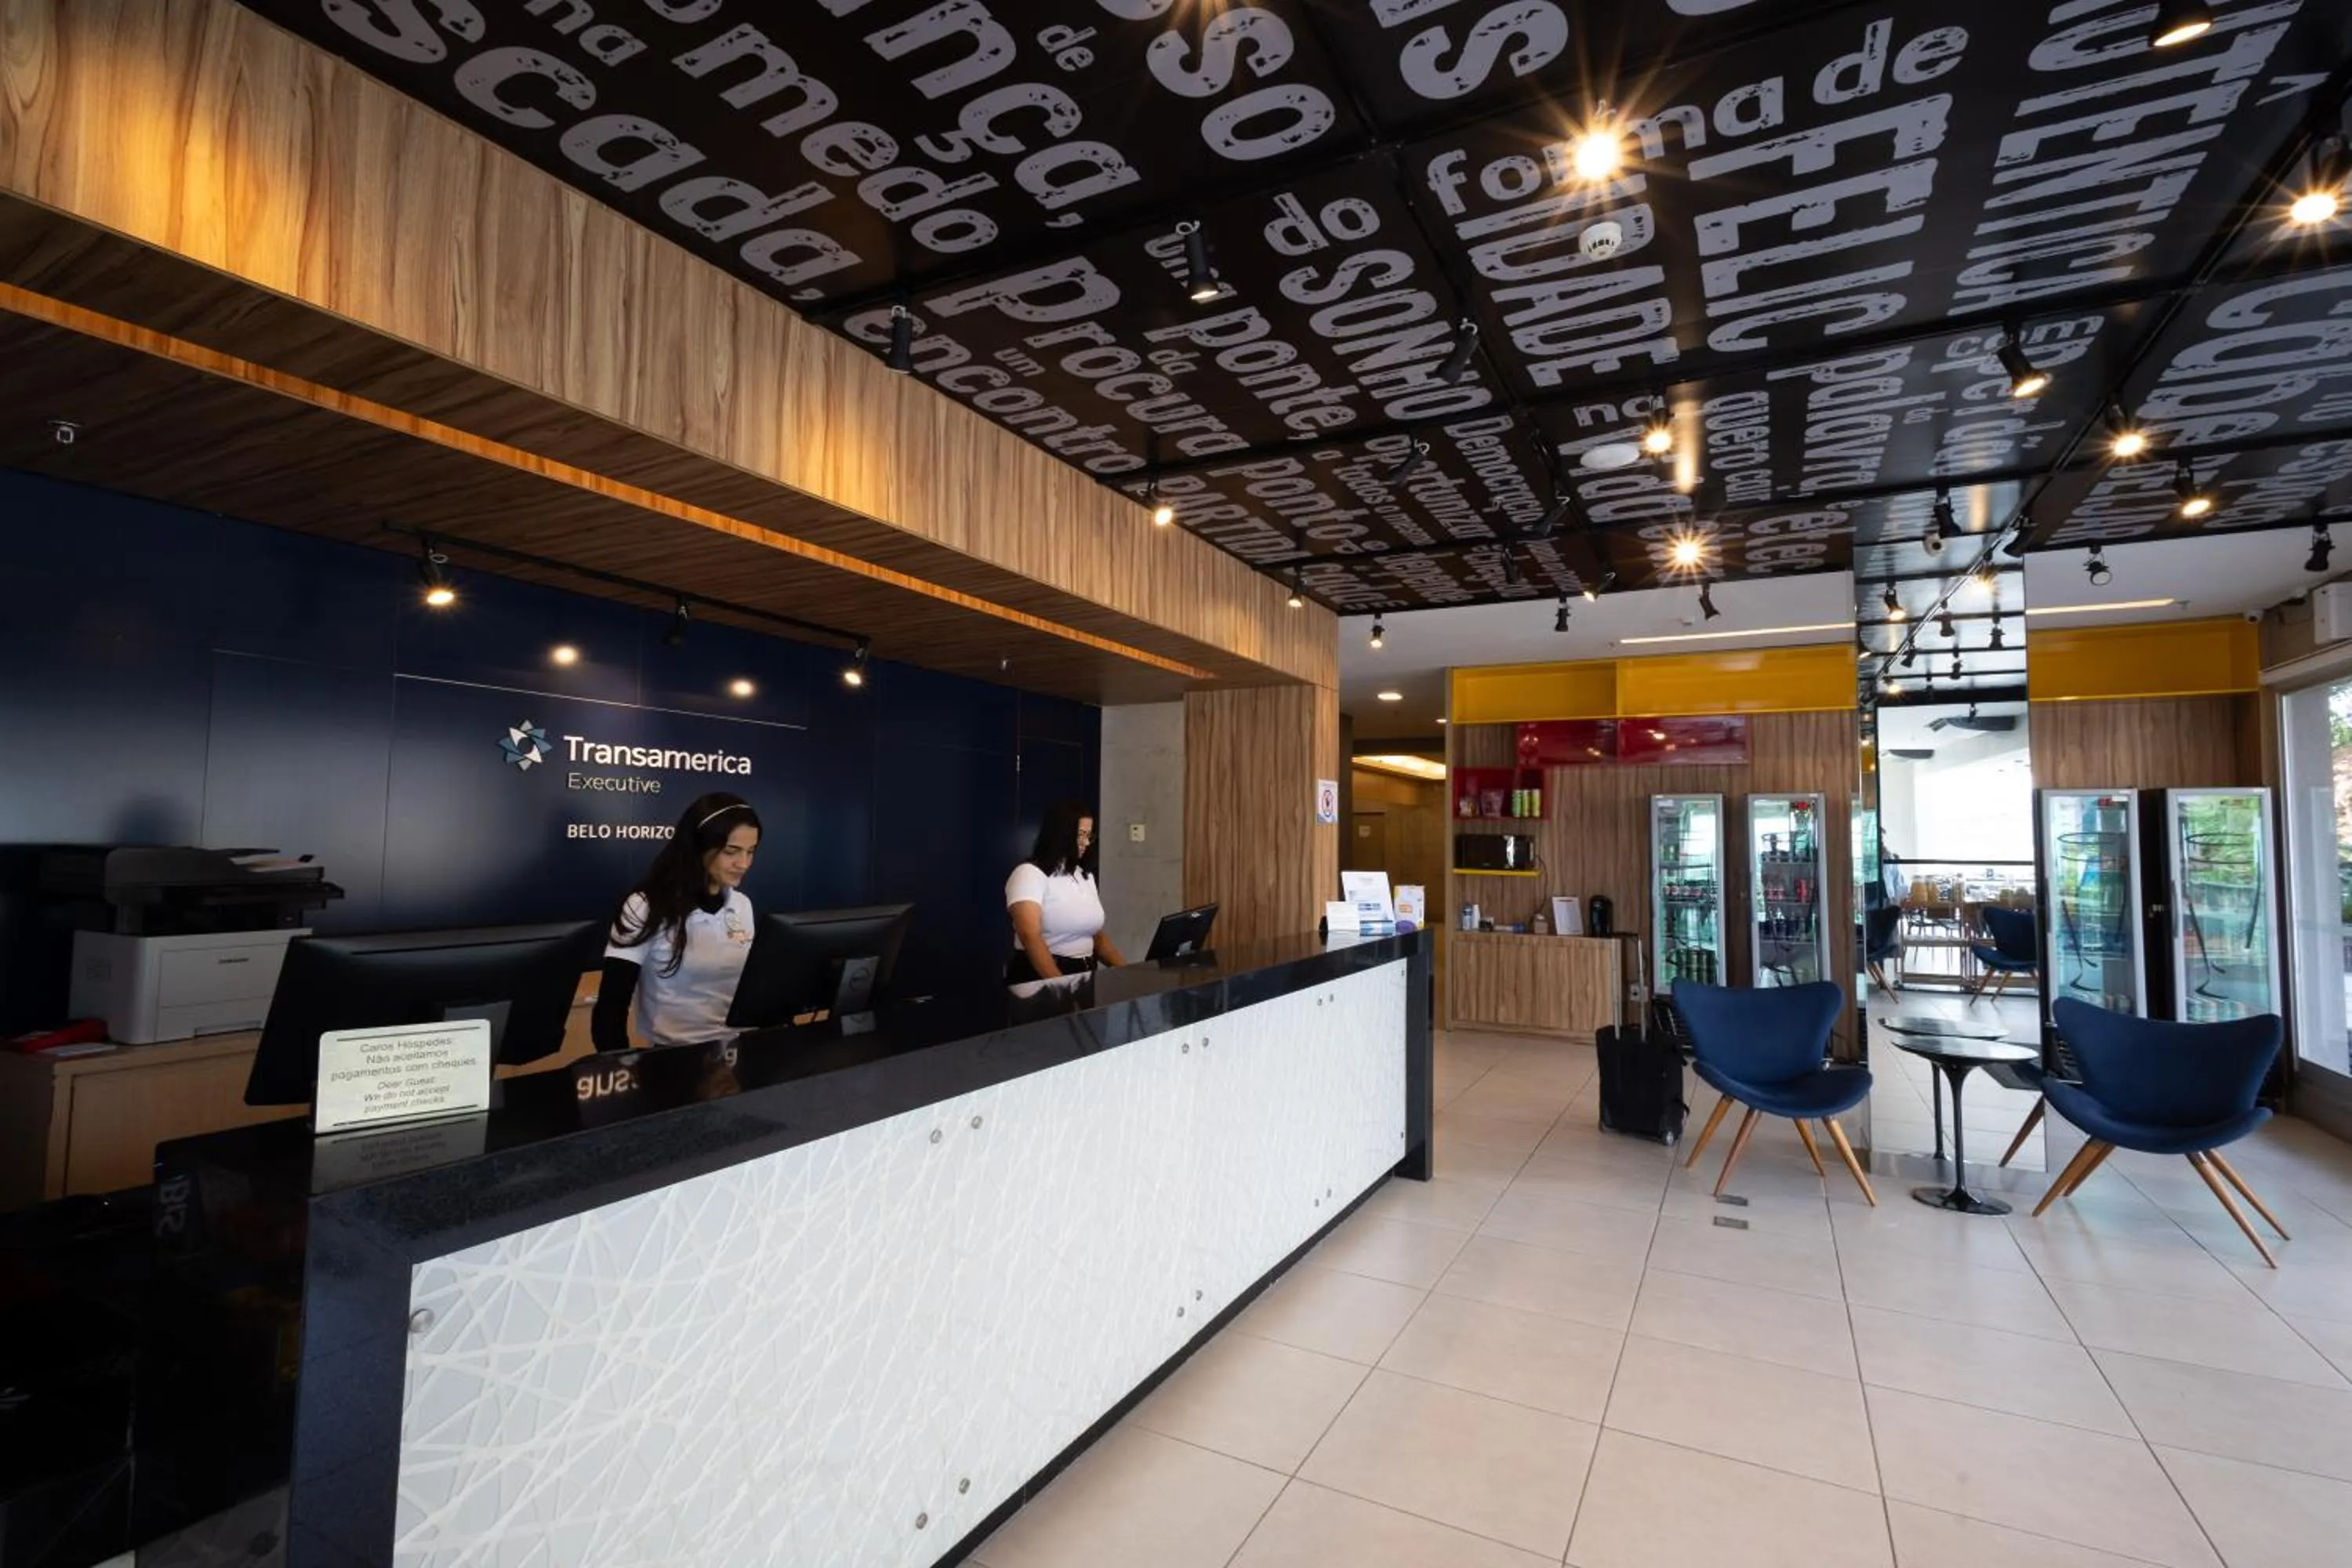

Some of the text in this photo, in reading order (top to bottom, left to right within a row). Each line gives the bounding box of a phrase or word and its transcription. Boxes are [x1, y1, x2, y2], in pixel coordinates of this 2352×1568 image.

[1037, 24, 1097, 71] de
[1813, 17, 1969, 105] de
[321, 0, 863, 300] scada,
[672, 23, 1052, 253] medo
[818, 0, 1142, 227] nça,
[1947, 0, 2330, 316] UTÊNTICA
[1264, 192, 1381, 256] do
[1688, 93, 1953, 352] FELIC
[994, 348, 1045, 377] um
[1143, 307, 1359, 440] ponte,
[1147, 350, 1200, 376] da
[1279, 249, 1492, 419] SONHO
[1945, 315, 2104, 358] com
[843, 309, 1147, 474] encontro
[1573, 394, 1665, 427] na
[1333, 463, 1397, 504] todos
[1700, 391, 1791, 503] quero cair
[1123, 475, 1314, 564] PARTIDA
[1206, 456, 1372, 540] ponto
[563, 735, 752, 775] Transamerica
[568, 772, 661, 793] Executive
[567, 824, 676, 840] BELO HORIZO
